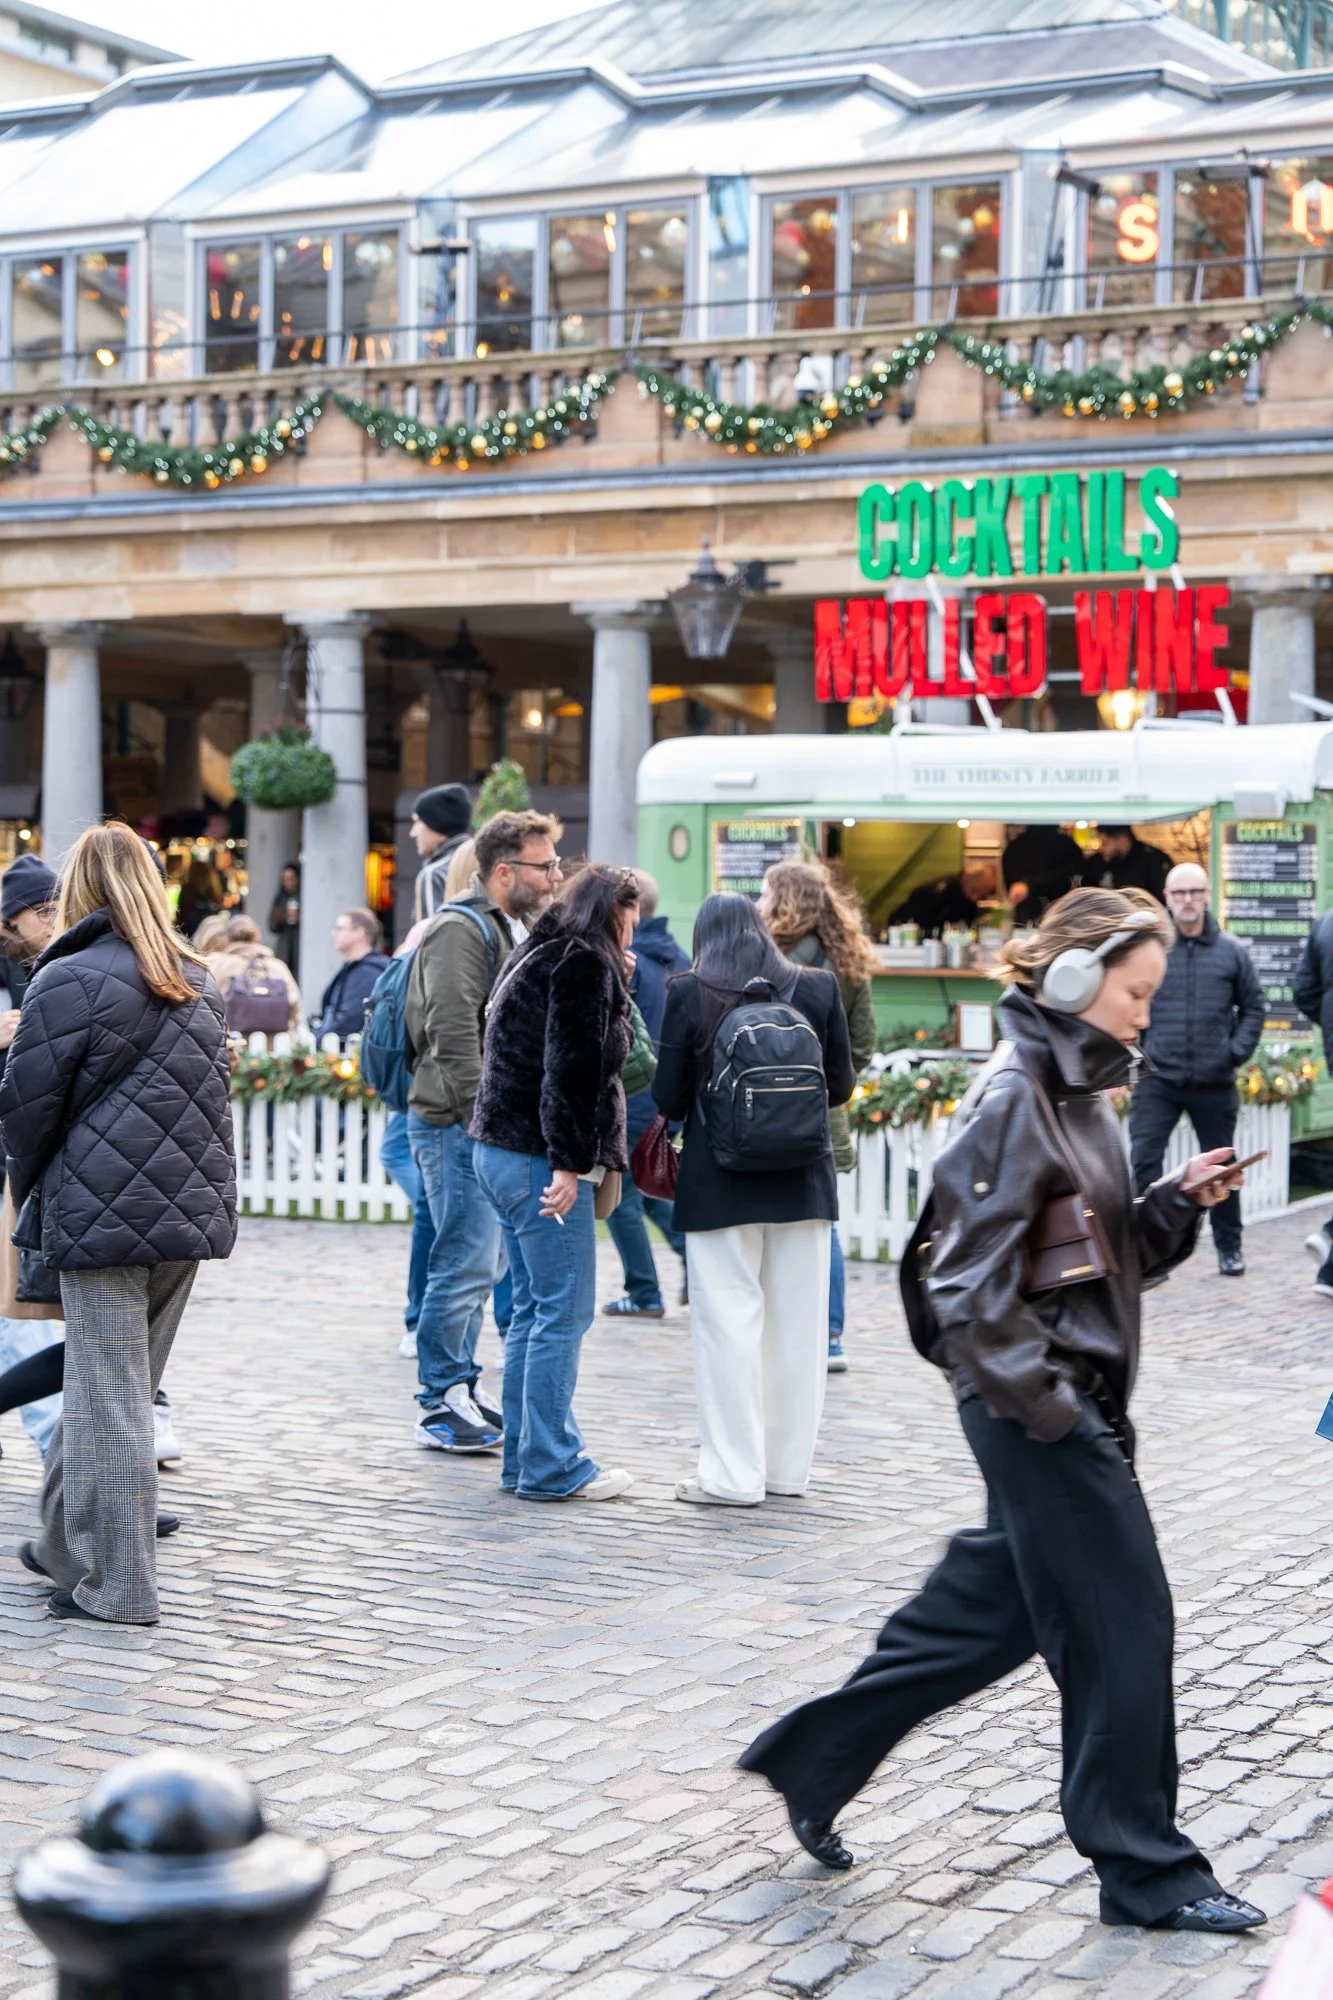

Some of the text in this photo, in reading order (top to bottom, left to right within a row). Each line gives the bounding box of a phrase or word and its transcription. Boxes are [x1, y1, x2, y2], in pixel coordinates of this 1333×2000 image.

[858, 467, 1180, 580] COCKTAILS
[814, 584, 1230, 702] MULLED WINE
[956, 767, 1034, 785] THIRSTY
[1236, 822, 1304, 842] COCKTAILS
